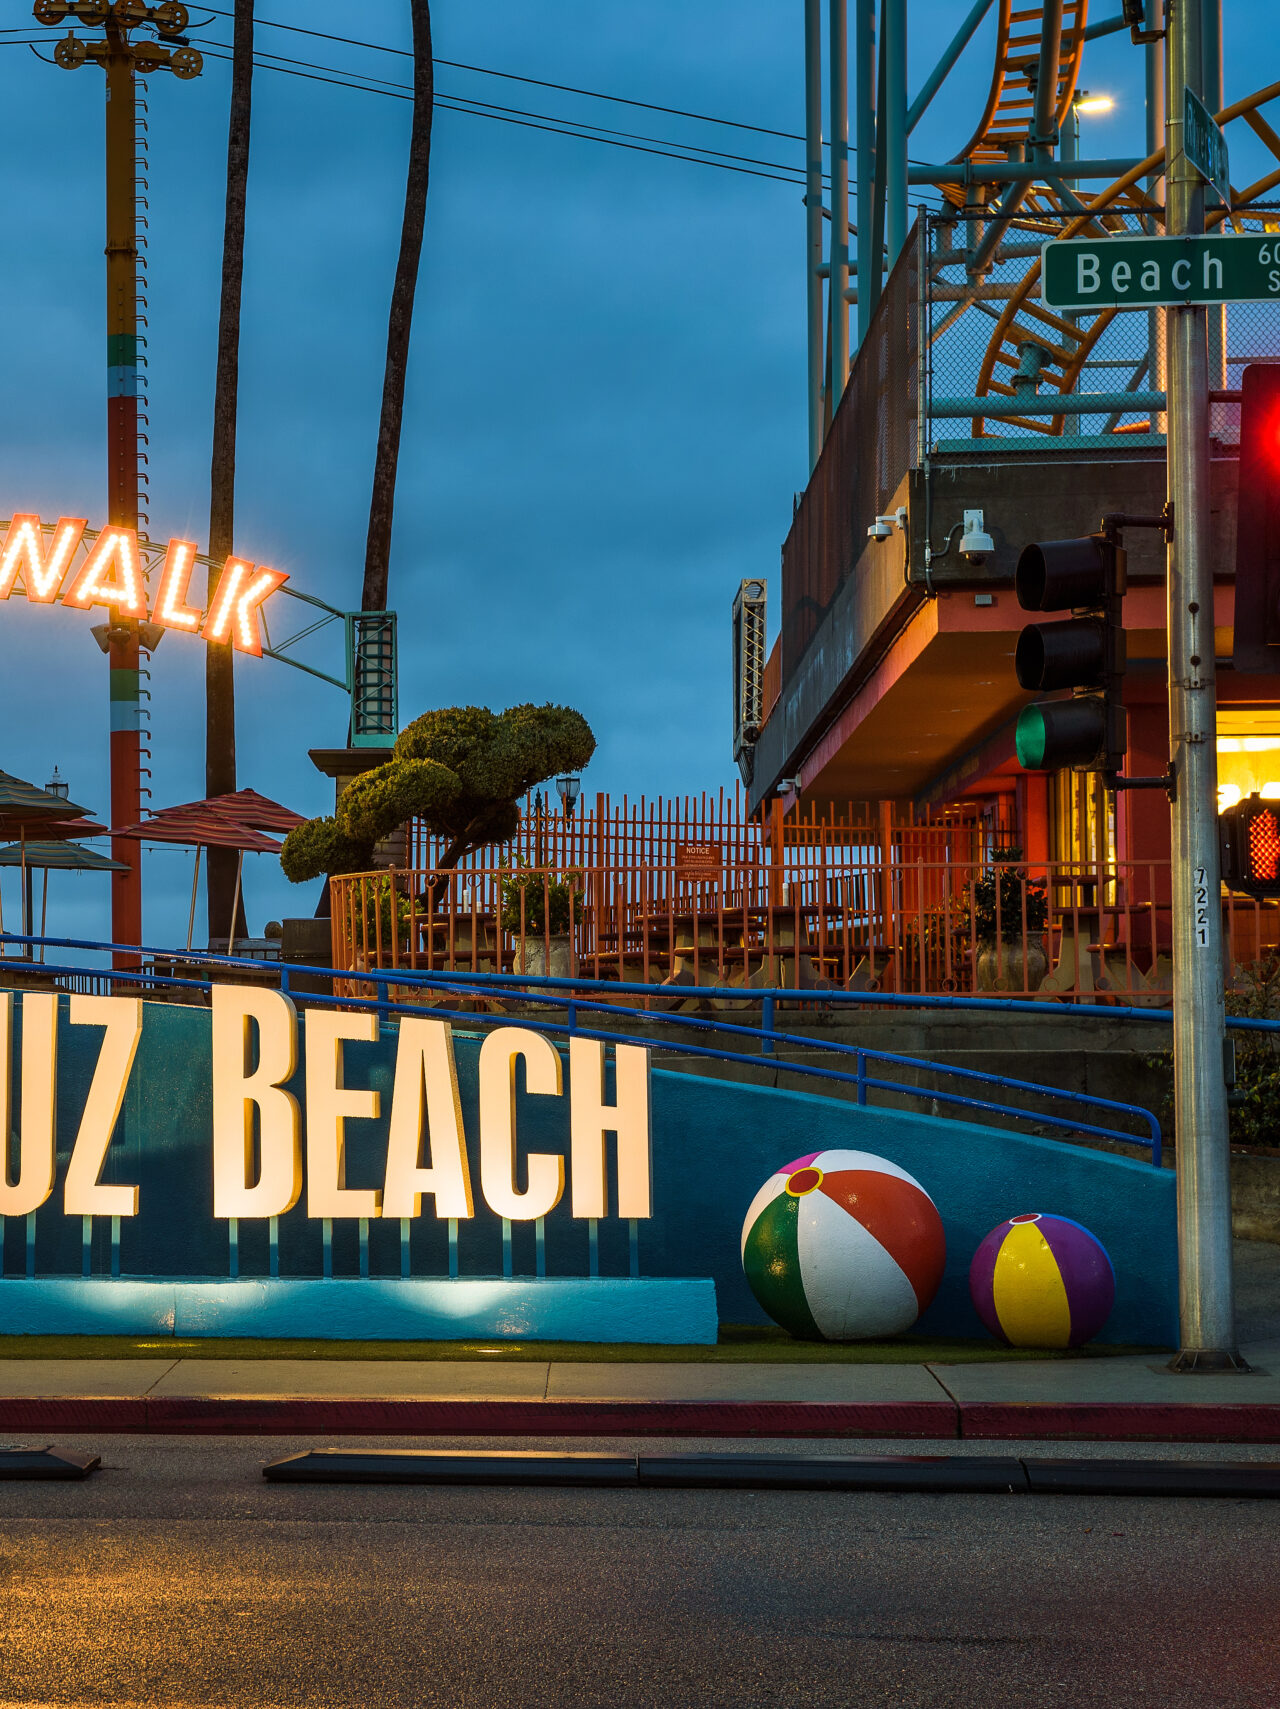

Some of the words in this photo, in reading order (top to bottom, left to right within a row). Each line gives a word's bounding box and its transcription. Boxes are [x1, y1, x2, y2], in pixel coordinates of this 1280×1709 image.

[1077, 250, 1223, 294] Beach
[1196, 868, 1207, 945] 7221
[211, 983, 653, 1221] BEACH
